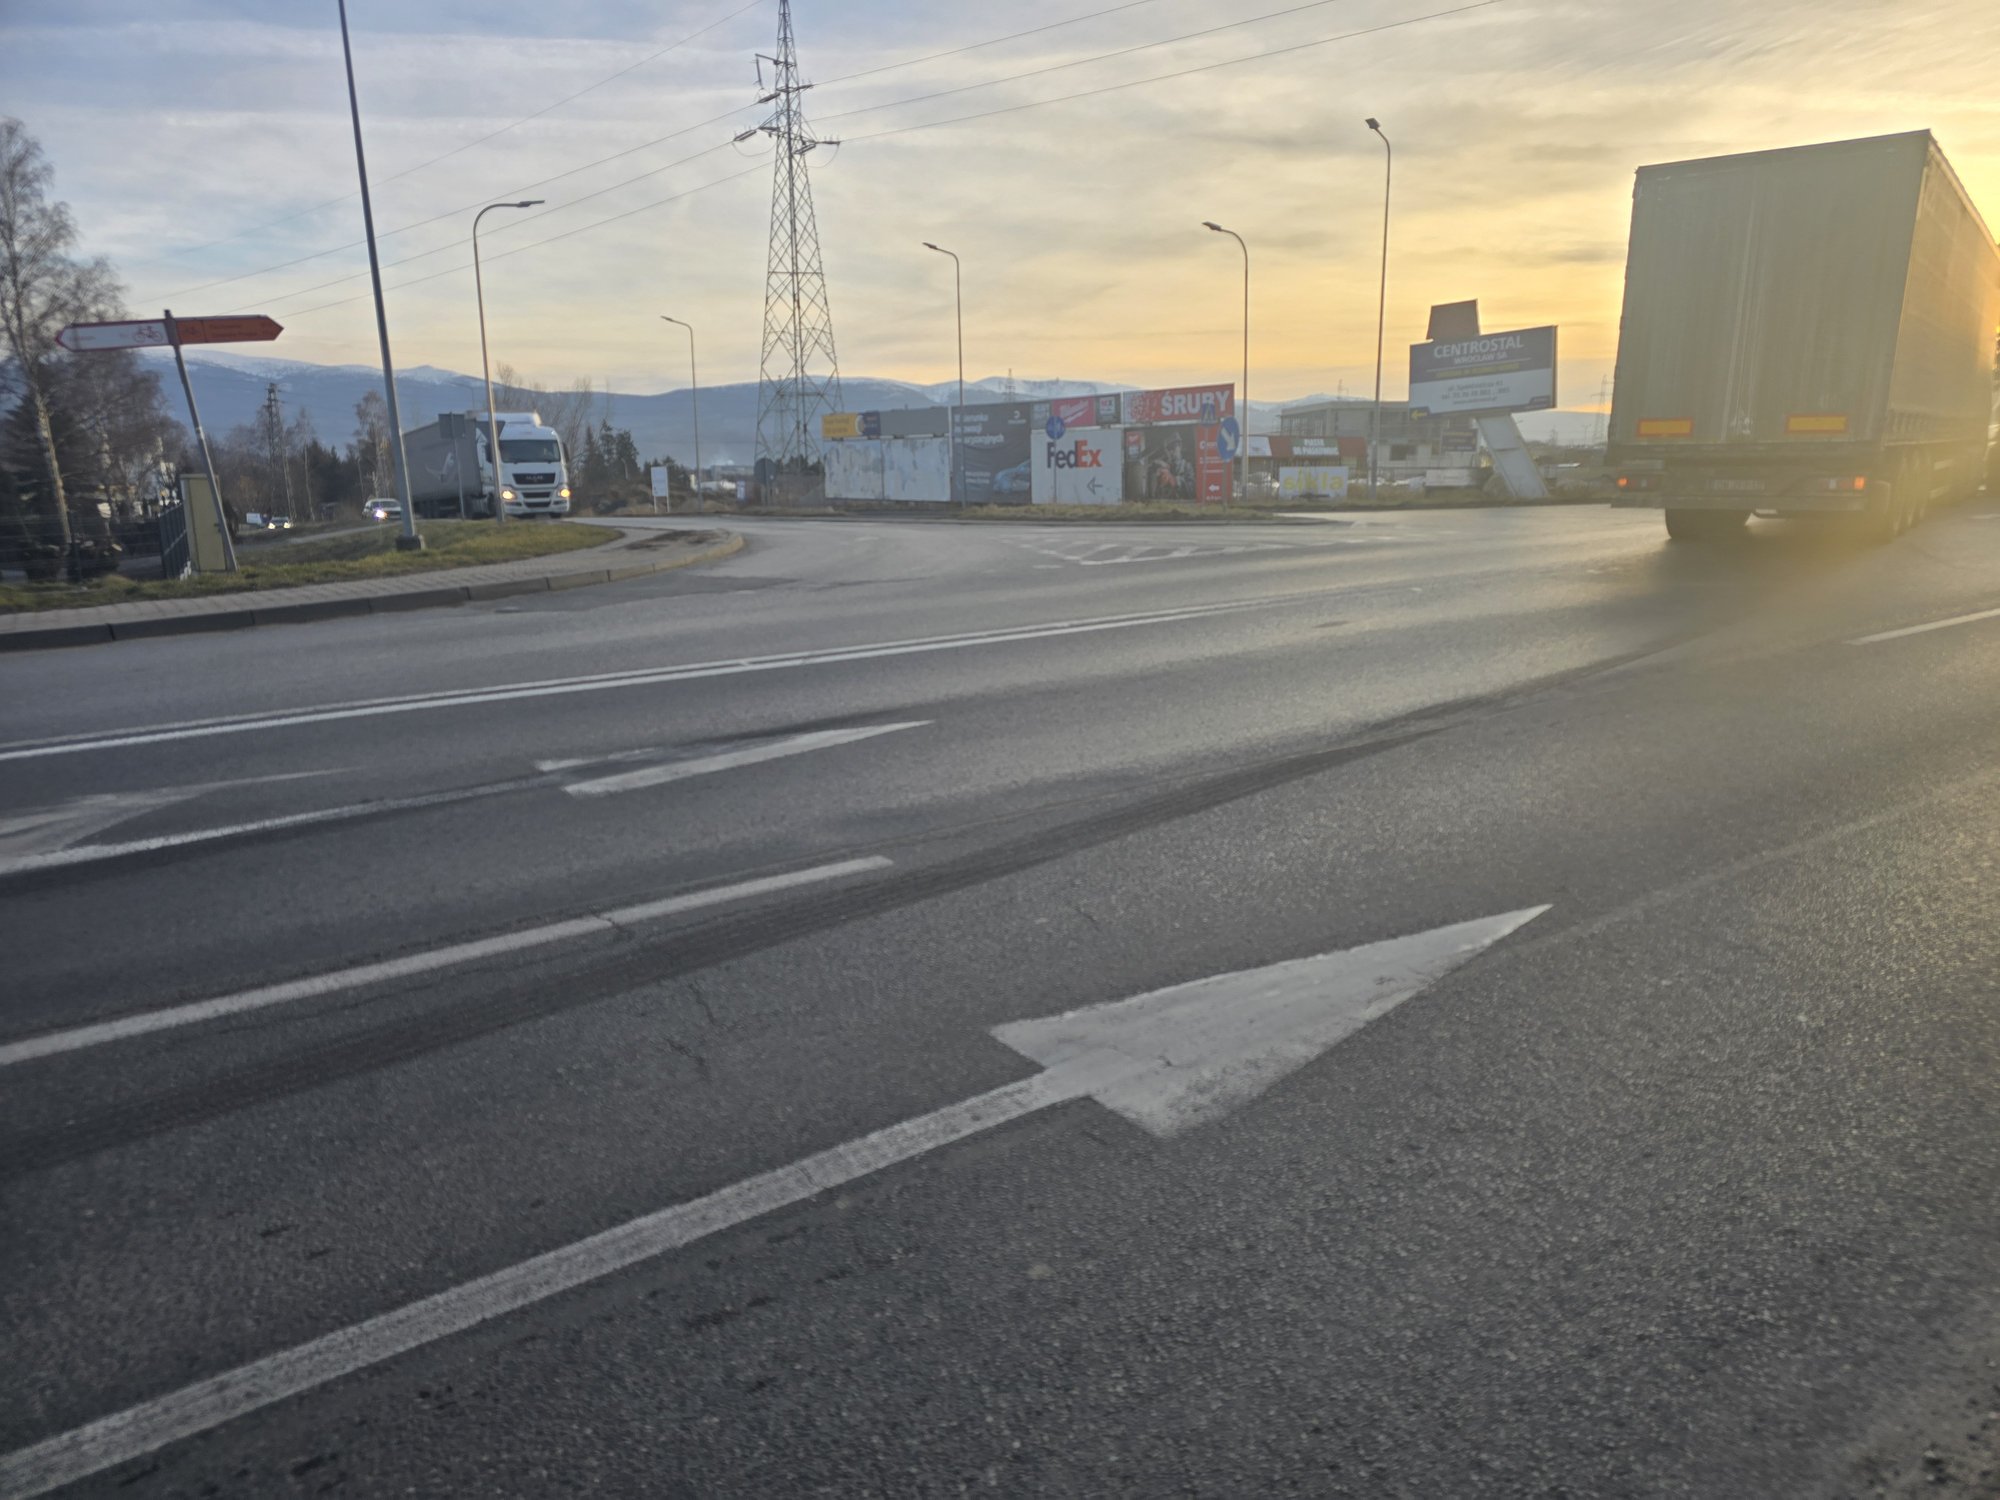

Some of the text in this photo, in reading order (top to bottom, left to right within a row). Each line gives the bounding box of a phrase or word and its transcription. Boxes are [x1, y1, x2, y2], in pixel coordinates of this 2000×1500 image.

[1434, 335, 1524, 358] CENTROSTAL
[1161, 390, 1230, 416] ŚRUBY
[1047, 440, 1103, 469] FedEx
